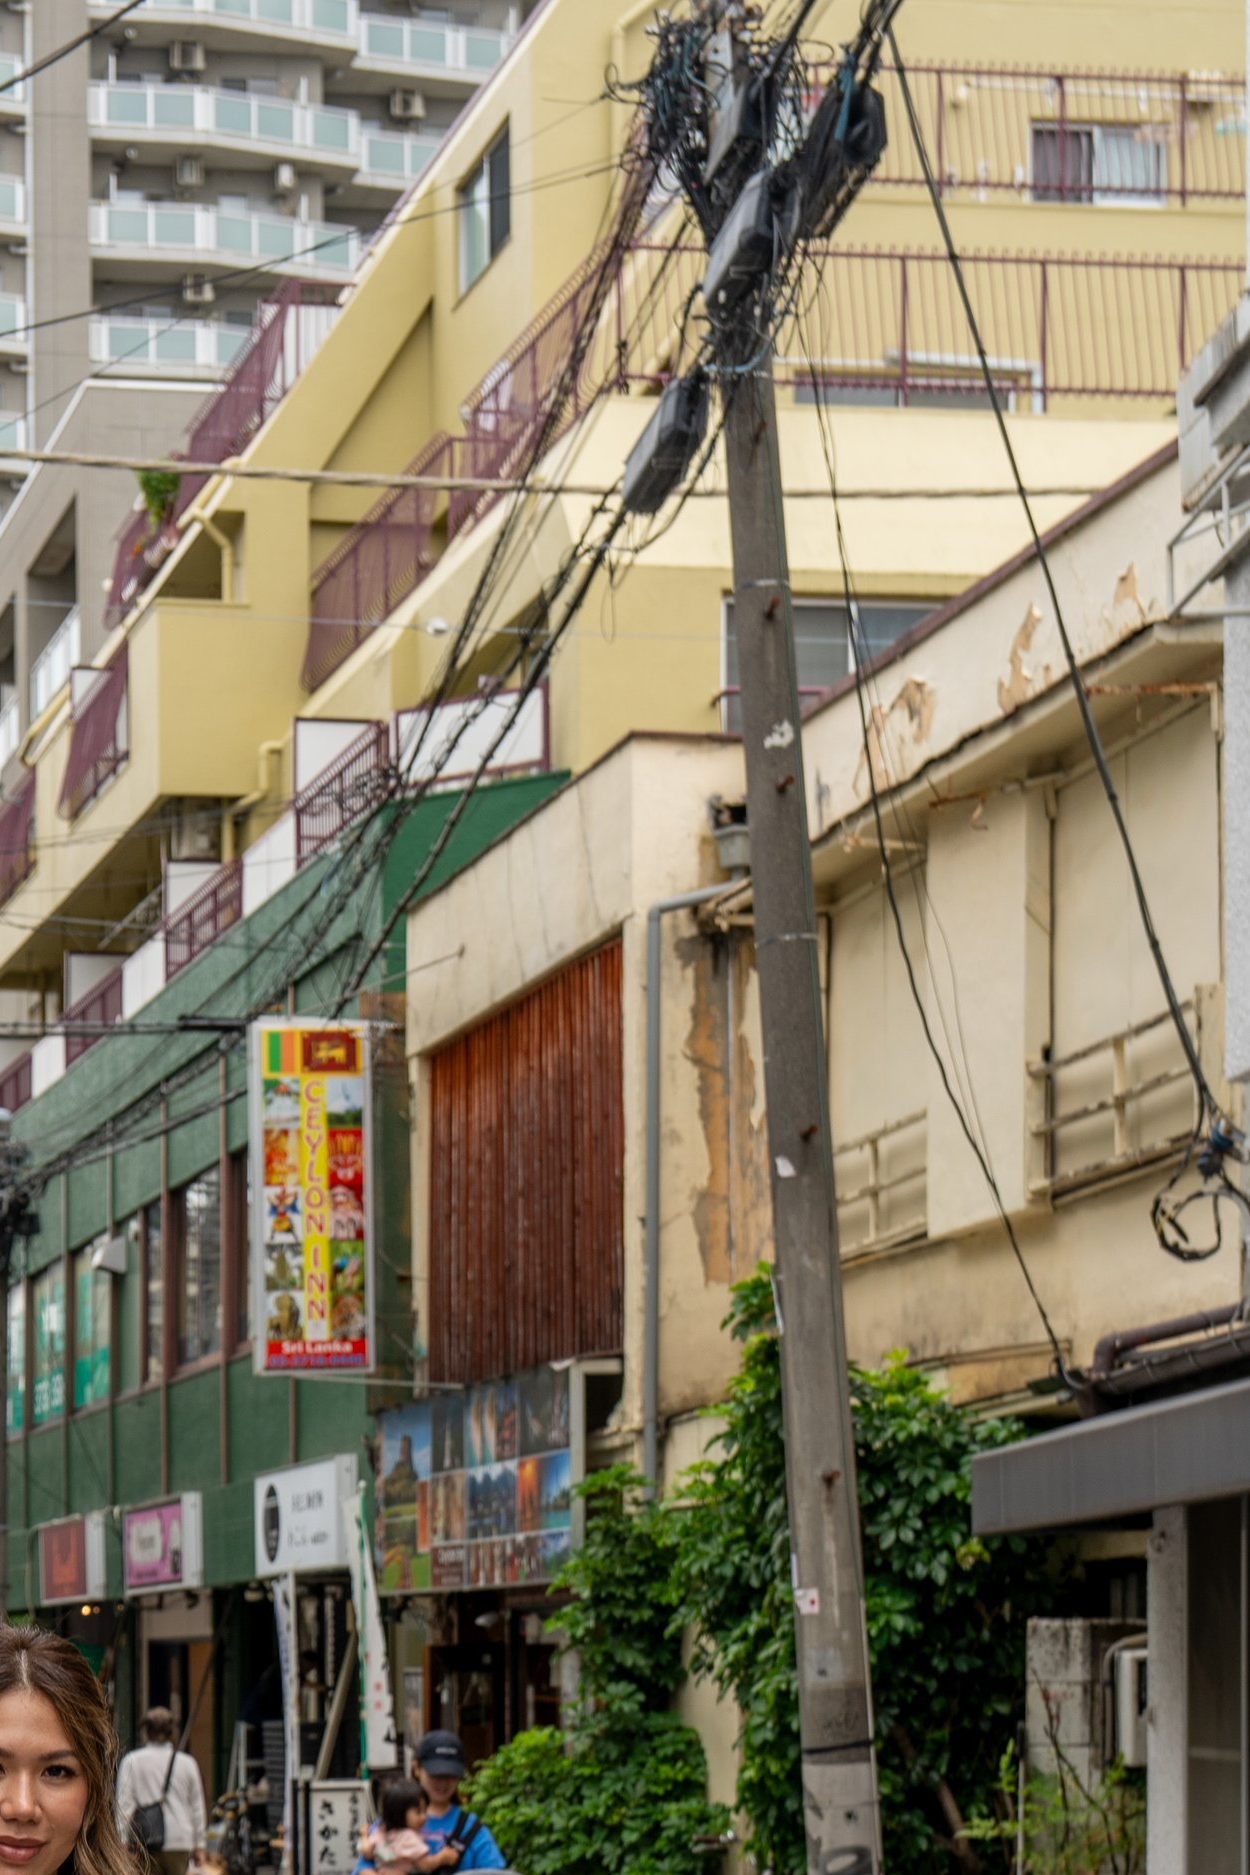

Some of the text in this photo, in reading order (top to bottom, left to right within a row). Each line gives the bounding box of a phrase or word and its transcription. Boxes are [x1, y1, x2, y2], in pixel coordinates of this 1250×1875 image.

[304, 1079, 328, 1321] CEYLON INN
[281, 1340, 354, 1355] Sri Lanka
